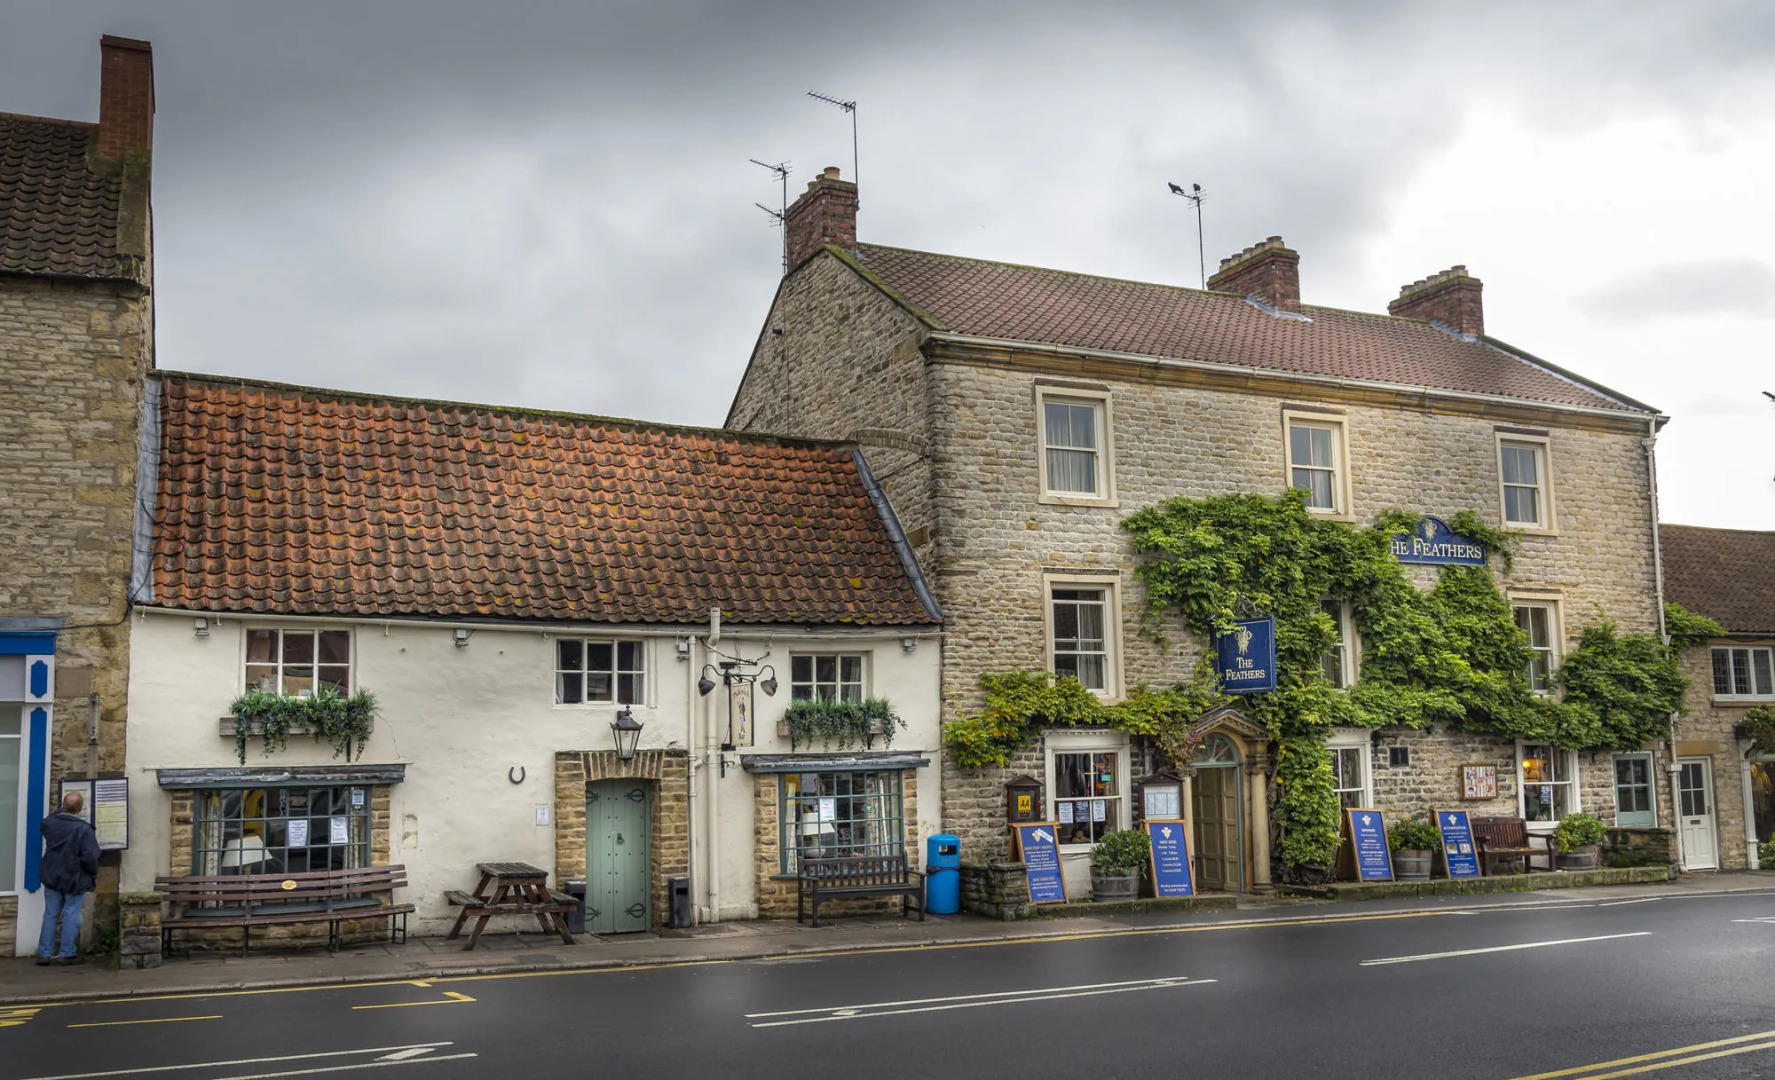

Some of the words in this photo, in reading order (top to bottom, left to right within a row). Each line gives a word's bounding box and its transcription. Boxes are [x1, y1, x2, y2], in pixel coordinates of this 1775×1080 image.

[1389, 541, 1409, 555] HE
[1413, 538, 1482, 558] FEATHERS
[1236, 657, 1253, 668] THE
[1226, 669, 1265, 680] FEATHERS
[1020, 799, 1030, 807] AA
